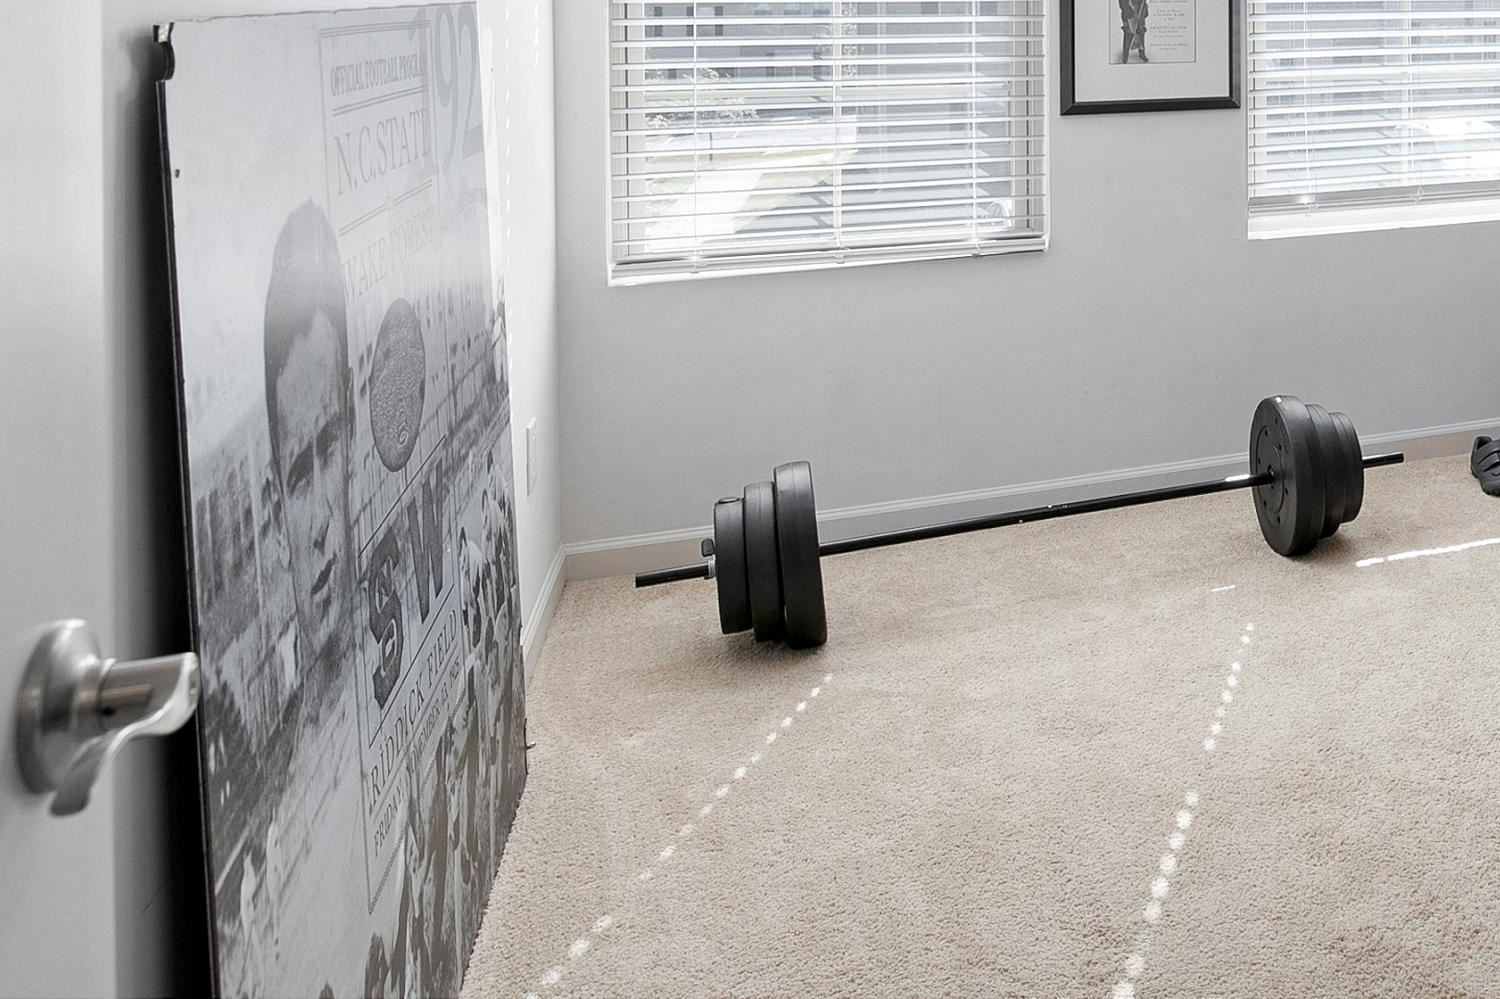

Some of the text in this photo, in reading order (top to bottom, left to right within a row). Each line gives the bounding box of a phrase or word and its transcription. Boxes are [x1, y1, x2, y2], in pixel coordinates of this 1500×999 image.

[328, 63, 364, 96] OFFICIAL
[365, 56, 399, 88] FOOTBALL
[371, 609, 457, 806] RIDDICK FIELD
